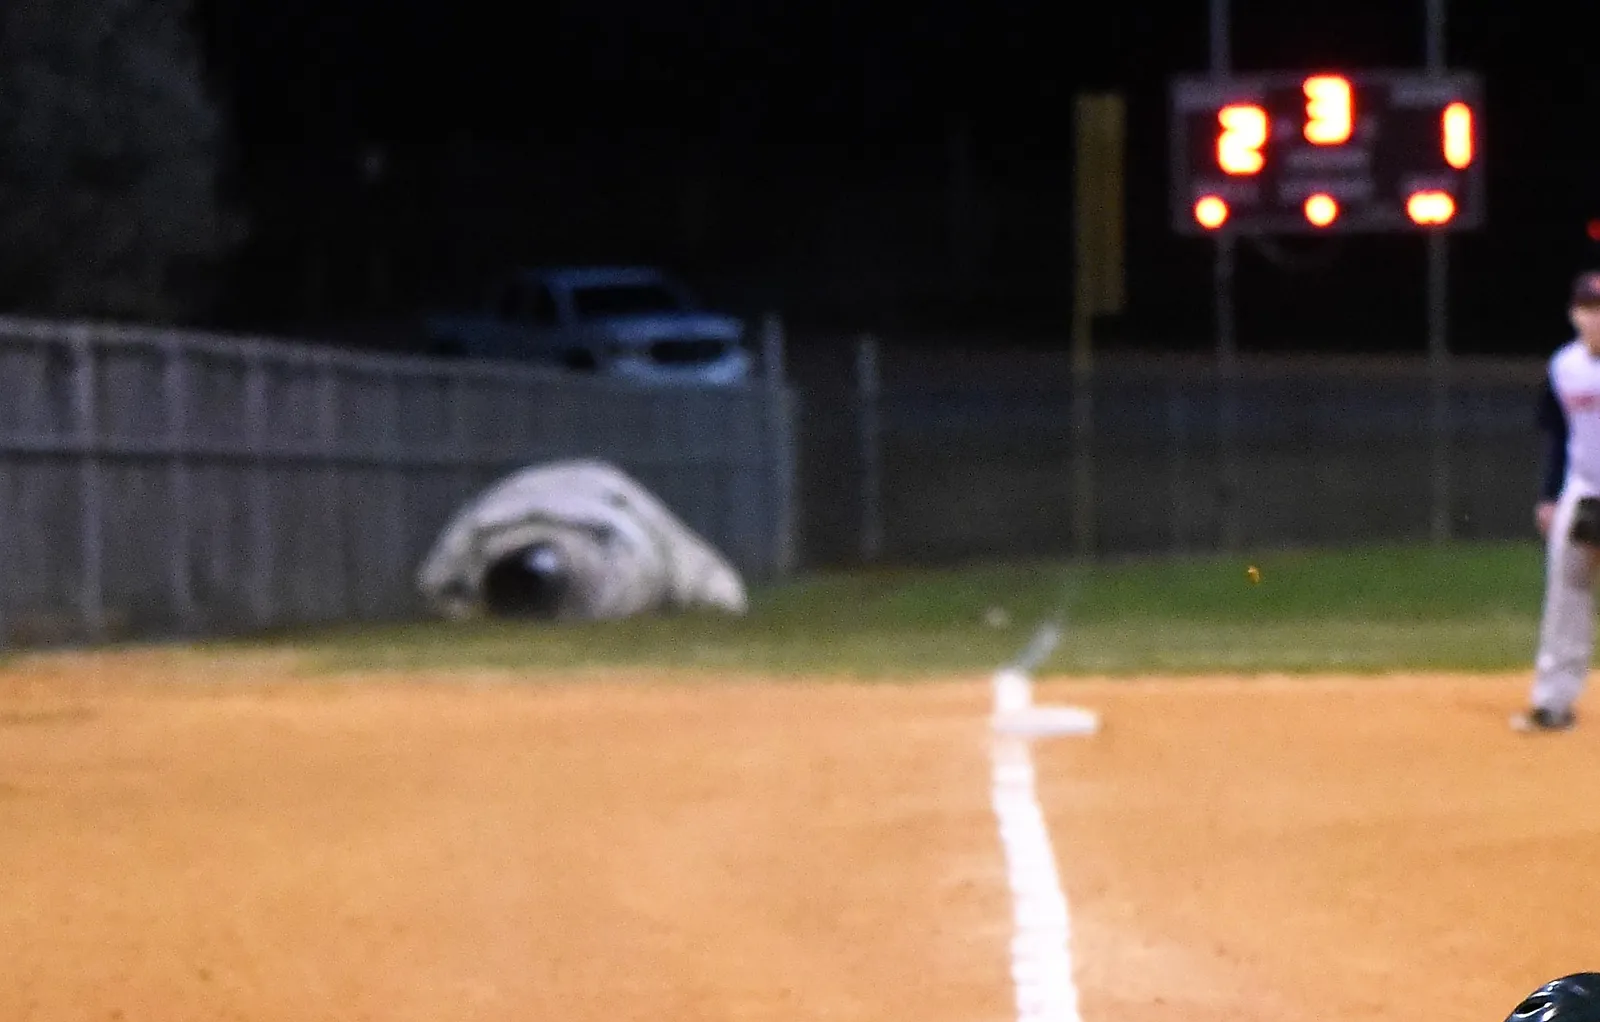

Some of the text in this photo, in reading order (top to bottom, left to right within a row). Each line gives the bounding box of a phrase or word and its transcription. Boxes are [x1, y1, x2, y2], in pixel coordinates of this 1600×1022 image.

[1217, 104, 1267, 175] 2
[1303, 75, 1351, 145] 3
[1443, 101, 1472, 169] 1
